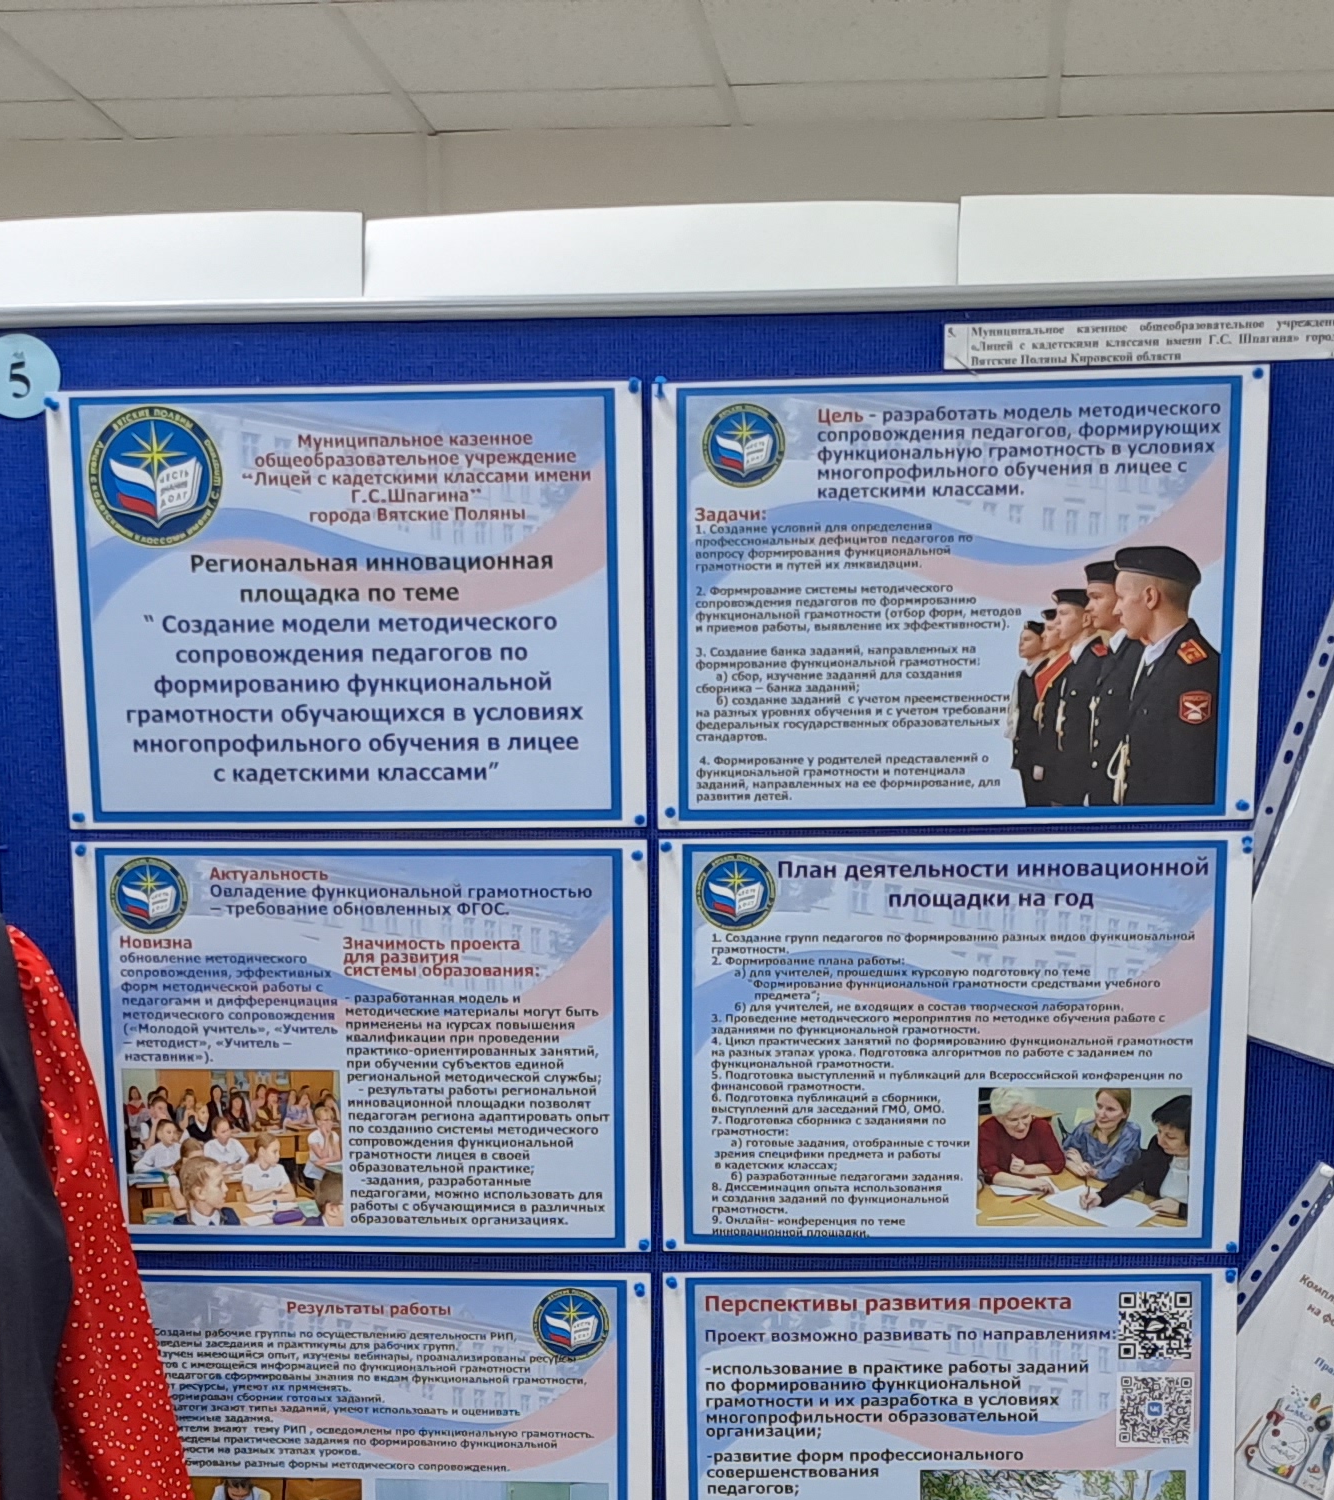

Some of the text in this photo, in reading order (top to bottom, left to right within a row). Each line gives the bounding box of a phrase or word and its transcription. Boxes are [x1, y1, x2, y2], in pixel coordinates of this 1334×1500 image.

[9, 361, 30, 398] 5
[818, 400, 1221, 427] Цель разработать модель методического
[297, 432, 533, 450] Муниципальное казенное
[817, 418, 1221, 444] сопровождения педагогов, формирующих
[255, 450, 576, 468] общеобразовательное учреждение
[817, 438, 1215, 464] функциональную грамотность в условиях
[318, 473, 326, 485] с
[331, 470, 439, 488] кадетскими
[444, 469, 534, 484] классами
[540, 469, 591, 484] имени
[817, 459, 1187, 483] многопрофильного обучения в лицее с
[817, 481, 1024, 502] кадетскими классами.
[309, 506, 526, 526] города Вятские Поляны
[695, 507, 767, 525] Задачи:
[191, 552, 553, 576] Региональная инновационная
[240, 584, 459, 606] площадка по теме
[162, 612, 557, 637] Создание модели методического
[176, 643, 527, 666] сопровождения педагогов по
[154, 671, 552, 697] формированию функциональной
[126, 703, 583, 727] грамотности обучающихся в условиях
[133, 733, 579, 757] многопрофильного обучения в лицее
[214, 766, 226, 783] с
[233, 764, 369, 785] кадетскими
[210, 866, 328, 883] Актуальность
[778, 856, 1209, 881] План деятельности инновационной
[210, 883, 592, 903] Овладение функциональной грамотностью
[889, 889, 1094, 911] площадки на год
[227, 901, 509, 919] требование обновленных ФГОС.
[120, 936, 192, 949] Новизна
[343, 936, 520, 953] Значимость проекта
[726, 932, 883, 945] Создание групп педагогов
[344, 950, 459, 965] для развития
[344, 963, 540, 980] системы образования:
[353, 993, 510, 1006] разработанная модель
[286, 1301, 451, 1318] Результаты работы
[705, 1292, 1072, 1314] Перспективы развития проекта
[705, 1326, 1116, 1345] Проект возможно развивать по направлениям:
[705, 1359, 1090, 1377] -использование в практике работы заданий
